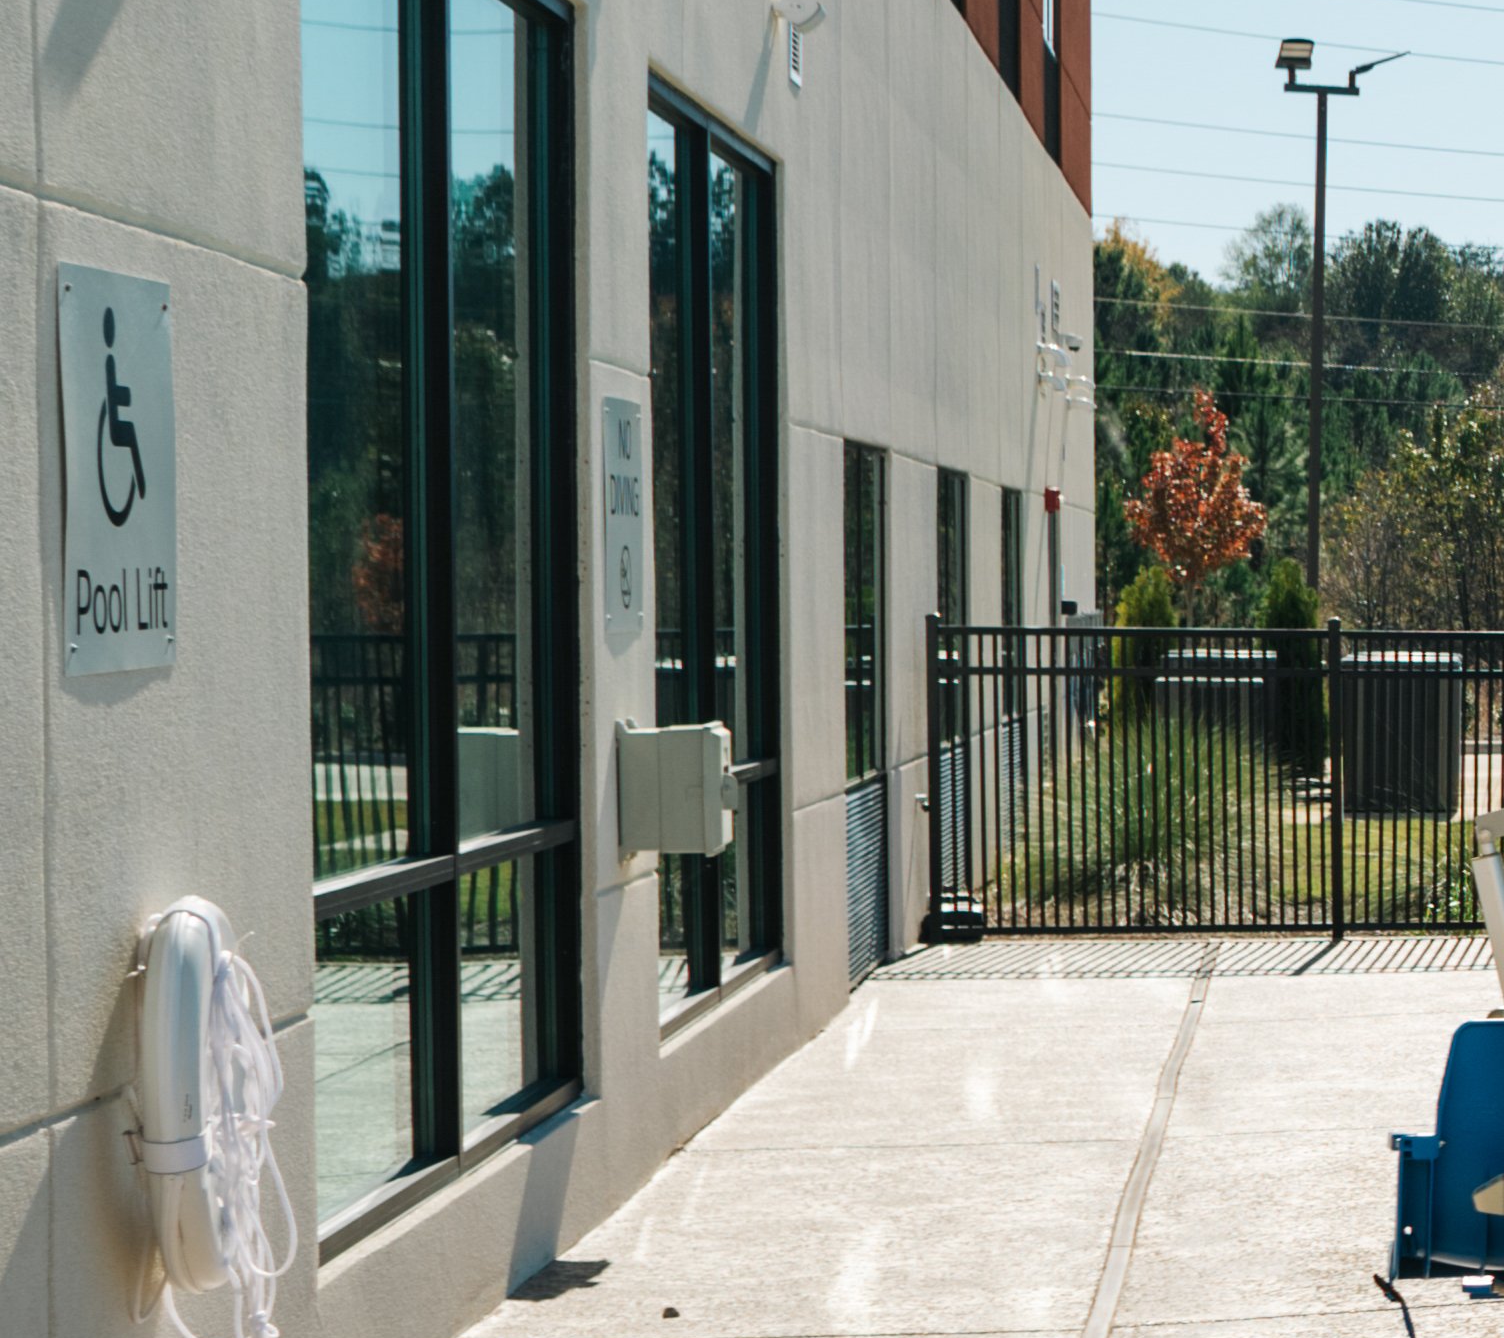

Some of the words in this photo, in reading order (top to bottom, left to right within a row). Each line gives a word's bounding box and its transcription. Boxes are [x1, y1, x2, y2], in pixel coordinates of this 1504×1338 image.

[618, 418, 632, 460] NO
[609, 473, 640, 517] DIVING
[76, 568, 128, 635] Pool
[136, 566, 168, 630] Lift
